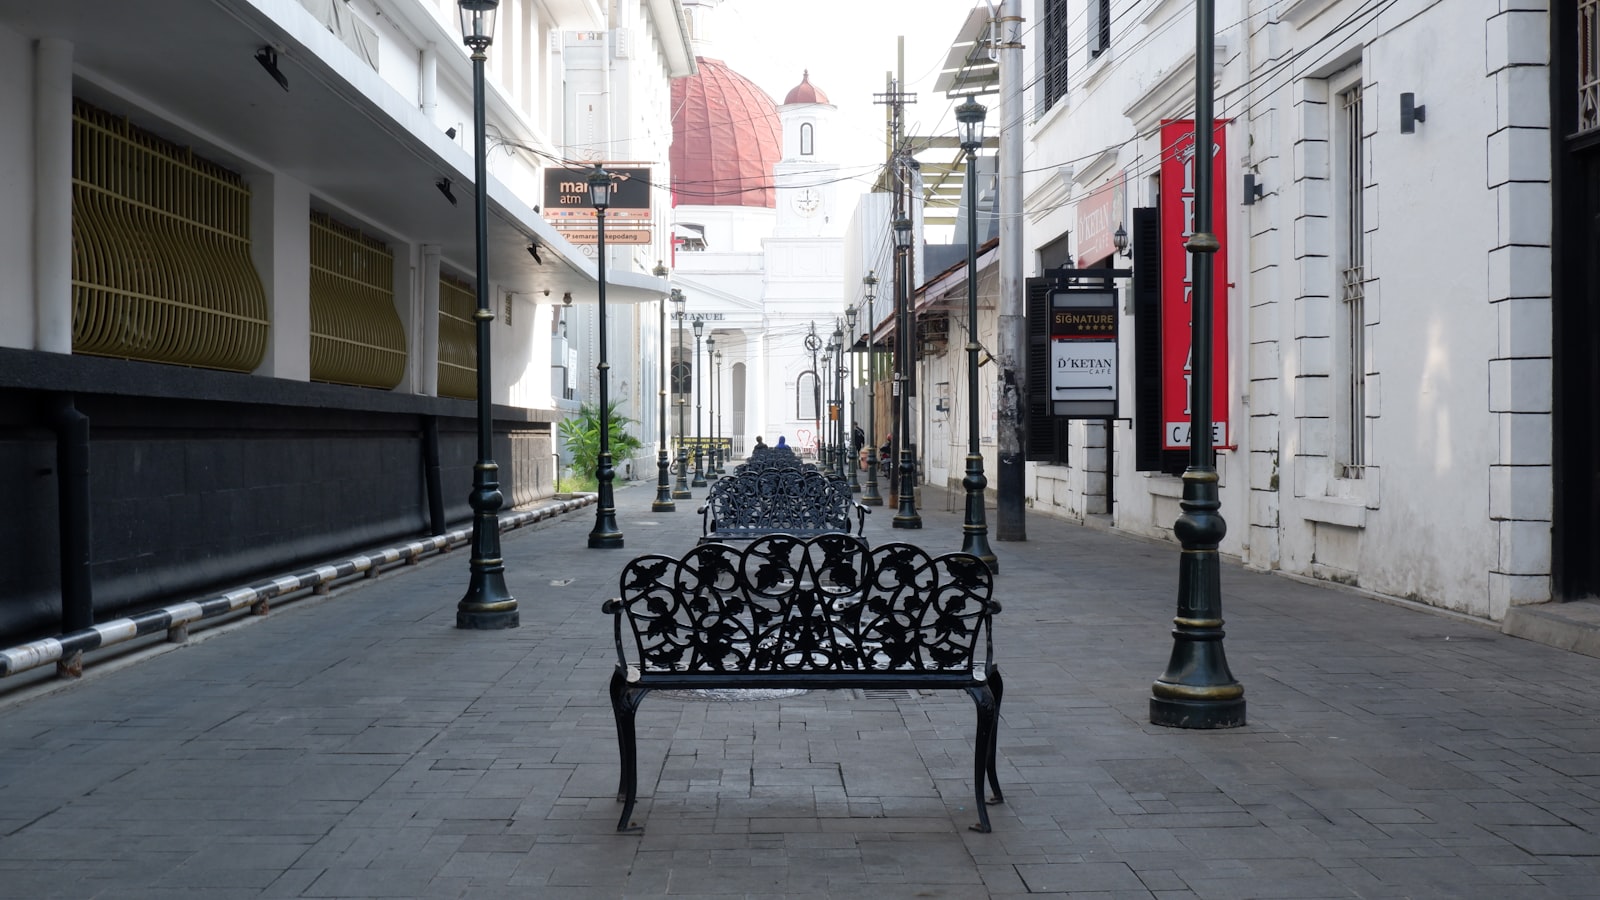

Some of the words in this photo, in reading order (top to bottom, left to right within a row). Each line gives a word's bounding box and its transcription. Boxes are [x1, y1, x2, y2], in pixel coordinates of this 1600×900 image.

[560, 195, 581, 204] atm
[1055, 314, 1114, 324] SIGNATURE
[1173, 422, 1219, 443] CÉ
